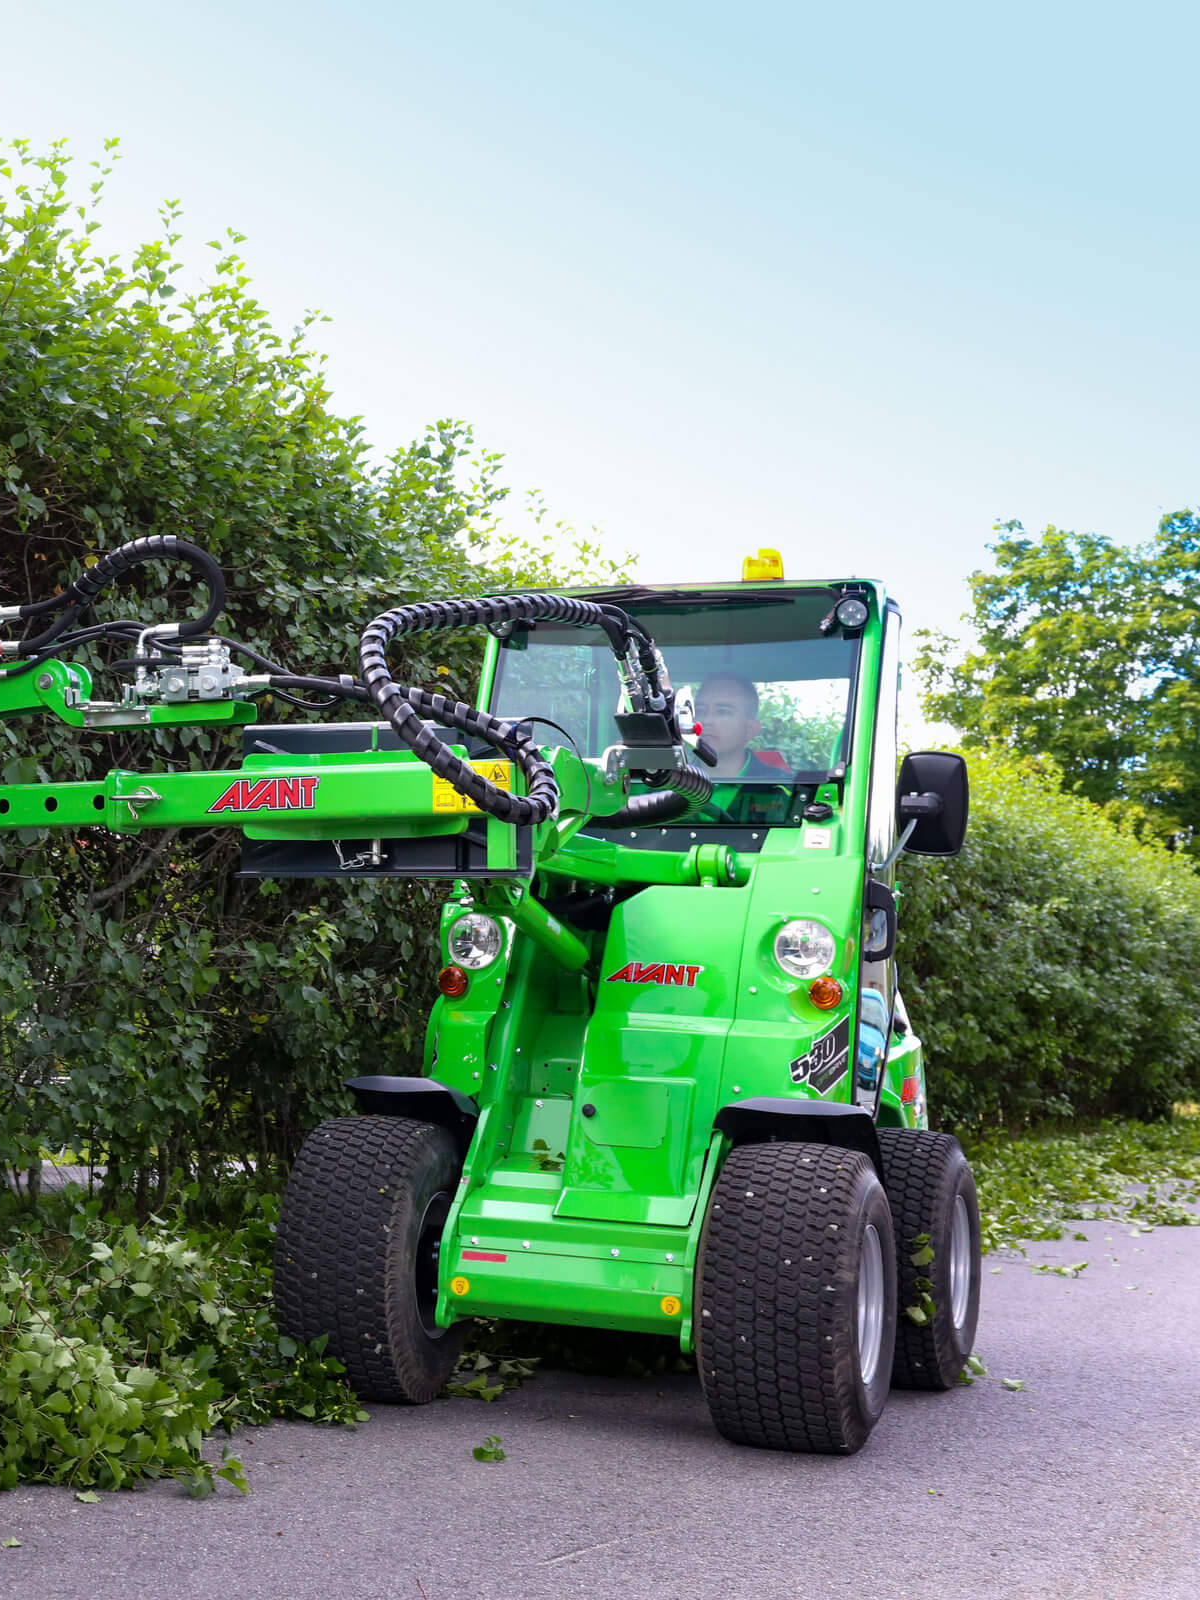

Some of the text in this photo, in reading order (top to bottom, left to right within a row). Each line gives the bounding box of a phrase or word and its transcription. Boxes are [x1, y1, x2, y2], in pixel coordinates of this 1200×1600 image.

[206, 776, 319, 812] AVANT
[605, 961, 702, 987] AVANT
[789, 1033, 835, 1083] 530
